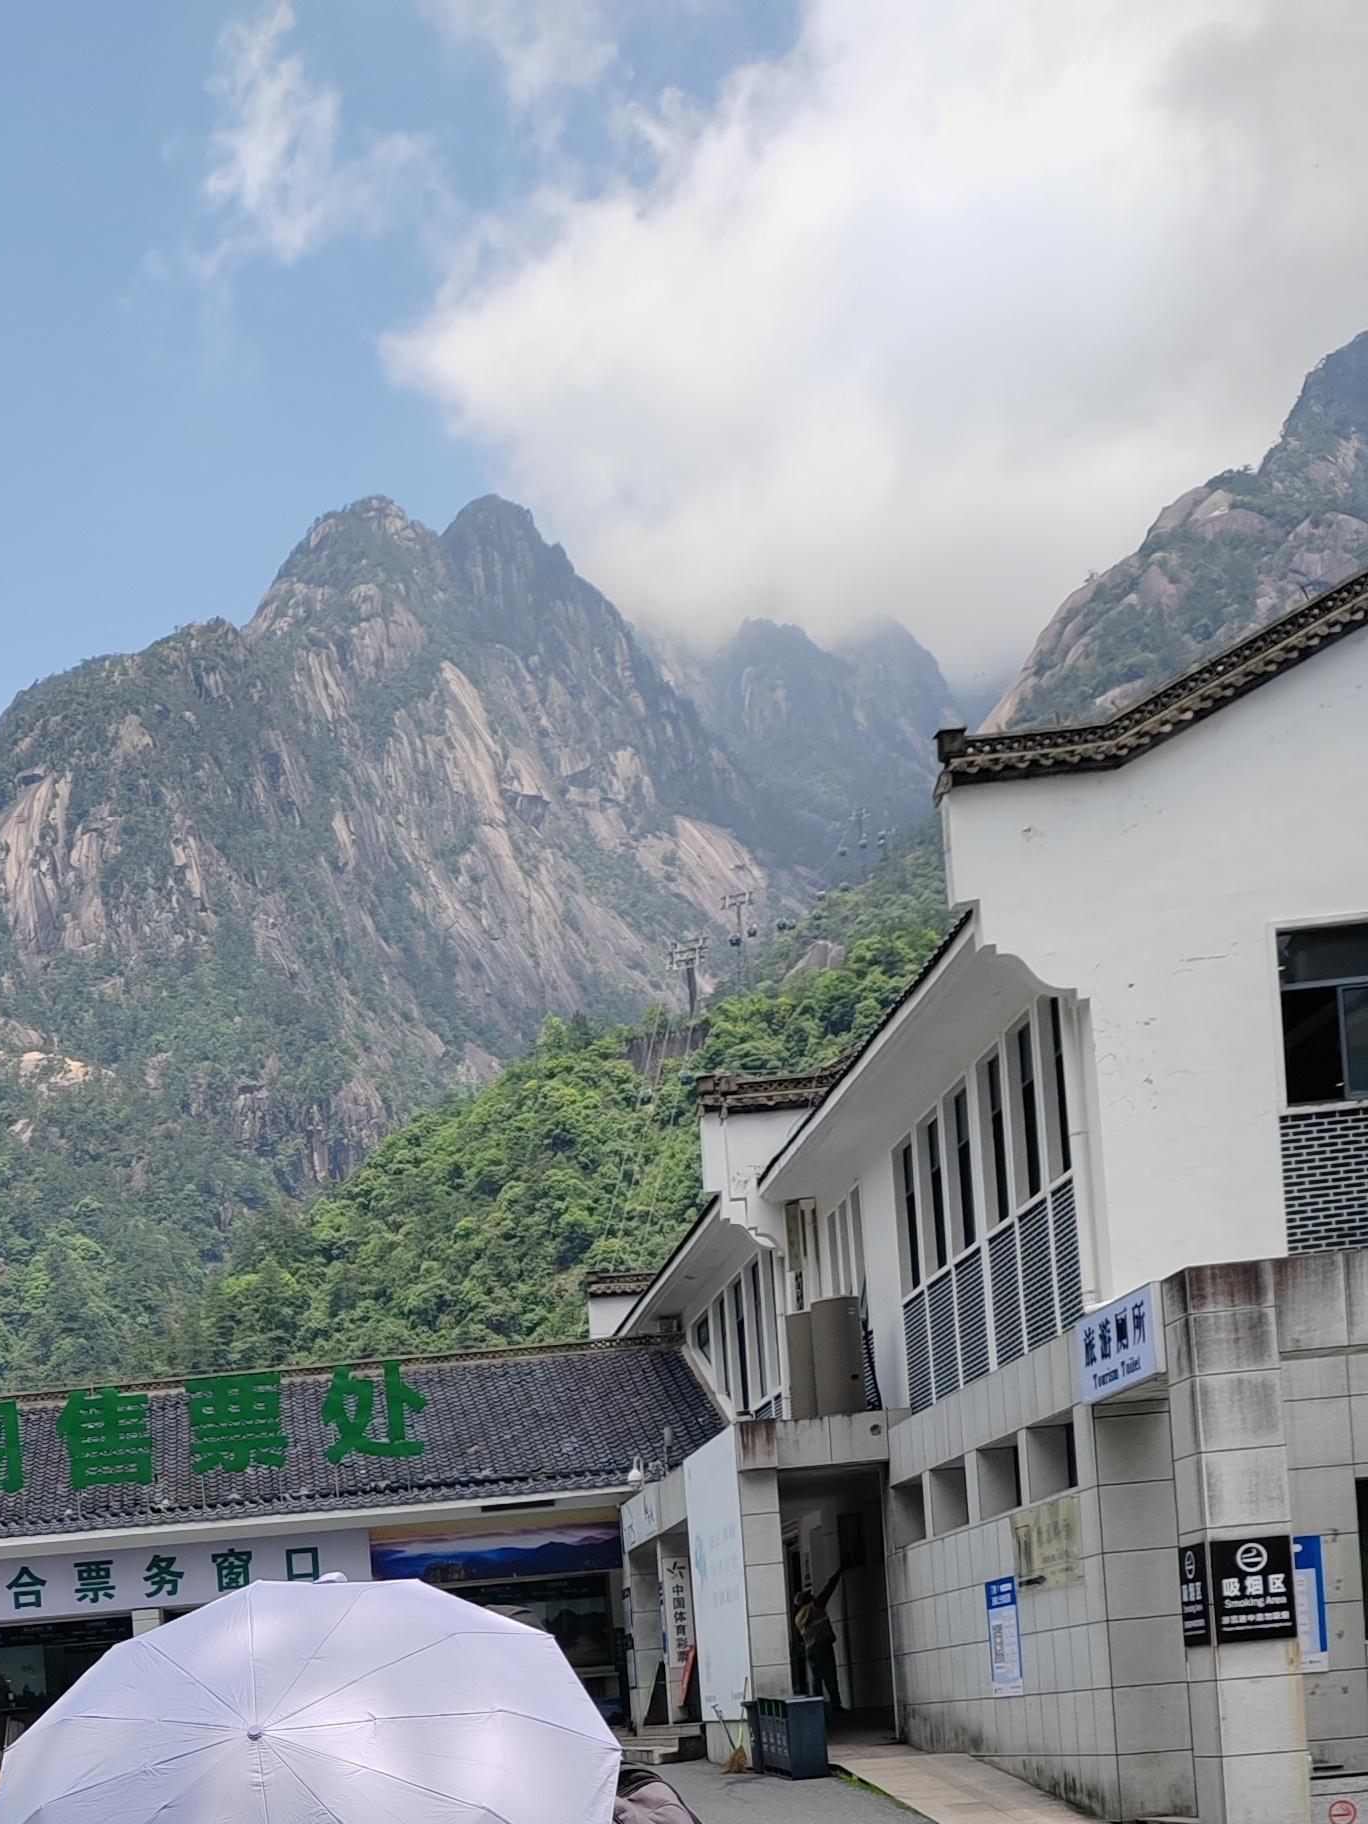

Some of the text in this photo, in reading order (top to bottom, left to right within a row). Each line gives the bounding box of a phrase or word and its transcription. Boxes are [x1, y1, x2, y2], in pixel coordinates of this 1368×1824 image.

[1083, 1299, 1146, 1368] 旅游厕所
[1092, 1367, 1119, 1390] Tourism
[1222, 1573, 1286, 1597] 吸烟区
[1224, 1595, 1287, 1608] Smoking Area
[671, 1583, 689, 1663] 中国体育彩票
